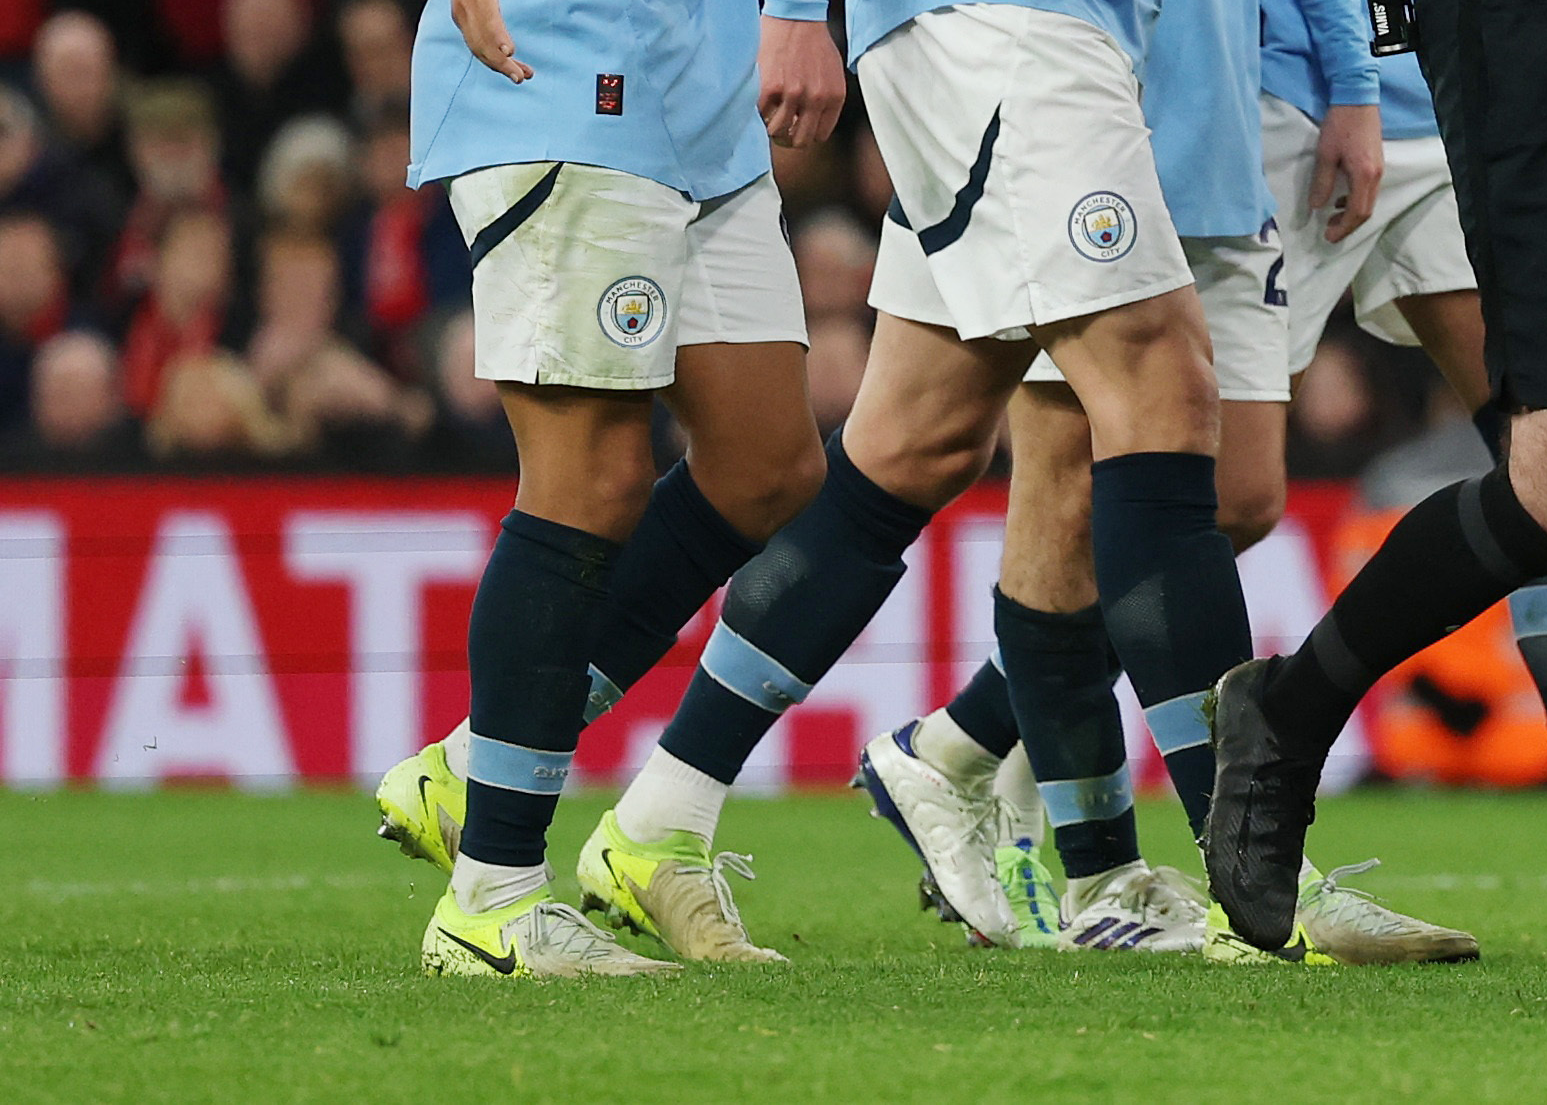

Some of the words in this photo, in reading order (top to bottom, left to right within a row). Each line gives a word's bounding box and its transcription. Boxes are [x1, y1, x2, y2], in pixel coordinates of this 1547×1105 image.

[1373, 2, 1390, 36] VANIS
[1074, 196, 1126, 225] MANCHESTER
[1101, 247, 1120, 258] CITY
[605, 281, 660, 305] MANCHESTER
[623, 336, 643, 344] CITY
